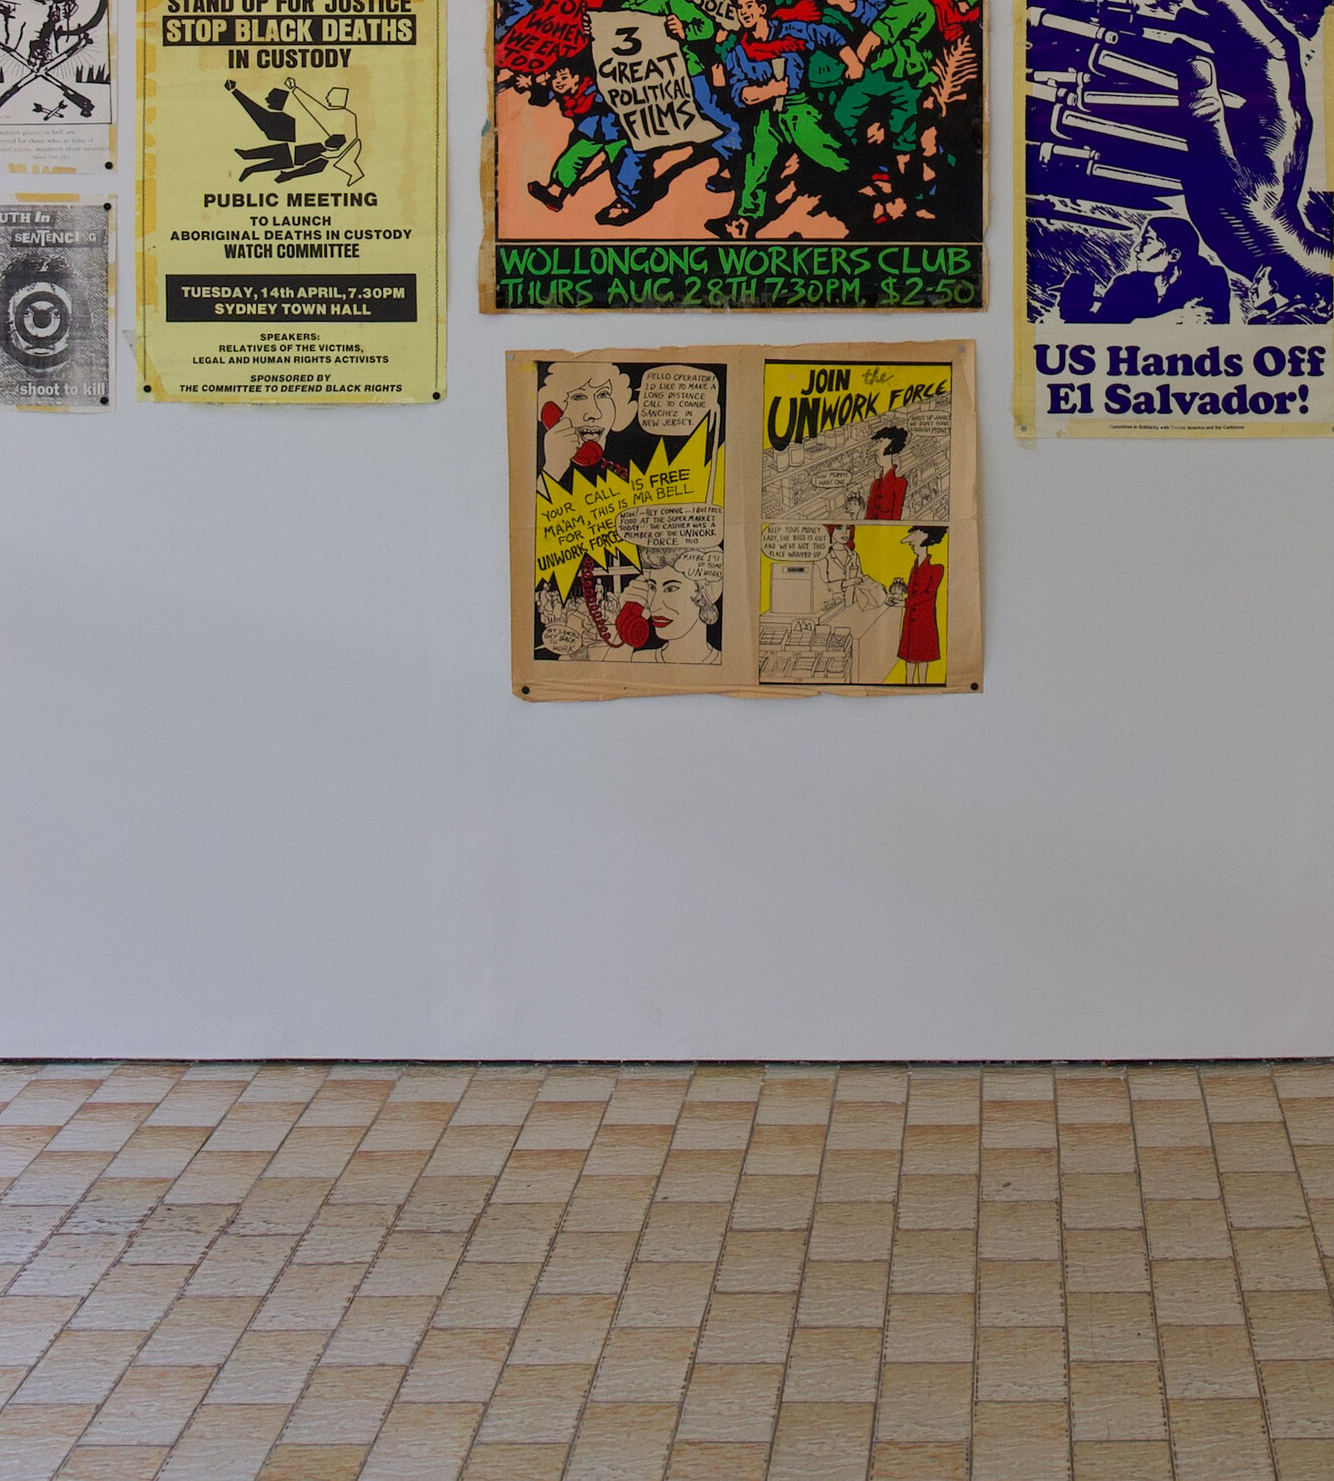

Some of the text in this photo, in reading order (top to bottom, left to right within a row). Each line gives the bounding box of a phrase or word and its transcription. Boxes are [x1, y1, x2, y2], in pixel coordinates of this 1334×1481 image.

[166, 18, 413, 43] STOP BLACK DEATHS
[610, 25, 643, 56] 3
[228, 48, 352, 69] IN CUSTODY
[598, 44, 678, 81] GREAT
[608, 76, 691, 107] POLITICAL
[624, 105, 698, 138] FILMS
[35, 211, 51, 223] In
[499, 246, 972, 278] WOLLONGONG WORKERS CLUB
[181, 287, 405, 301] TUESDAY, 14th APRIL, 7.30PM
[1033, 345, 1326, 377] US Hands Off
[20, 382, 106, 395] shoot to kill
[801, 367, 894, 396] JOIN the
[888, 379, 949, 413] FORCE
[1047, 383, 1309, 415] El Salvador!
